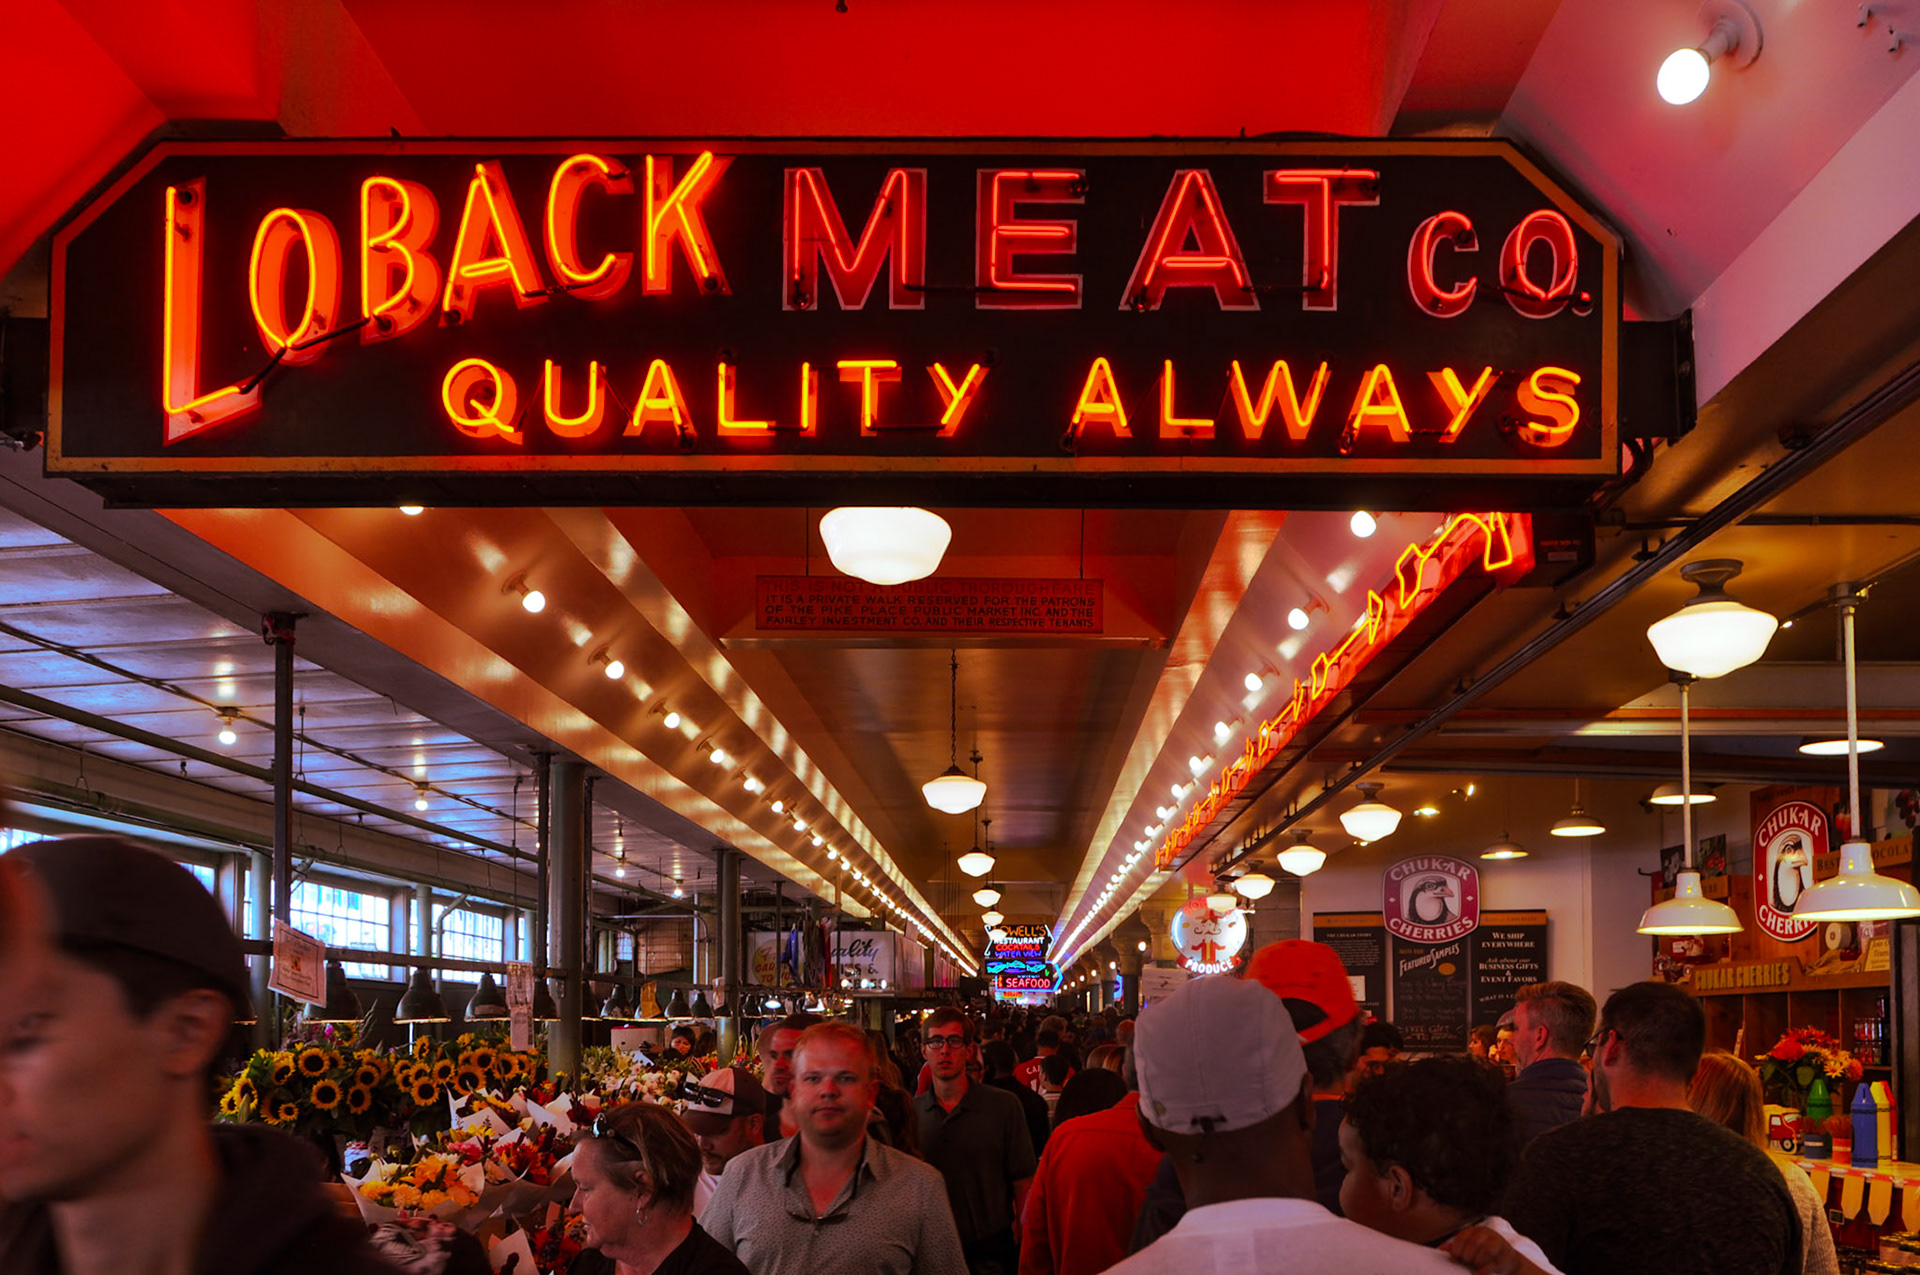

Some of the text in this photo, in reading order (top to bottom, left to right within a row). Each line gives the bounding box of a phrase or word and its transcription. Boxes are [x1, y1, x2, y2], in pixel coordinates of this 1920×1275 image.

[163, 150, 735, 446] LOBACK
[783, 168, 1380, 311] MEAT
[442, 356, 1582, 449] QUALITY ALWAYS
[763, 580, 801, 592] THIS
[809, 581, 822, 591] IS
[830, 581, 865, 592] NOT
[962, 583, 1096, 595] THOROUGHFARE
[766, 594, 1096, 607] IT IS A PRIVATE WALK RESERVED FOR THE PATRONS
[765, 605, 785, 614] OF
[790, 605, 814, 615] THE
[821, 606, 854, 615] PIKE
[861, 606, 907, 616] PLACE
[914, 607, 966, 617] PUBLIC
[967, 607, 1017, 617] MARKET
[1045, 608, 1069, 618] AND
[1071, 609, 1095, 618] THE
[822, 617, 899, 626] INVESTMENT
[926, 617, 948, 627] AND
[953, 618, 985, 627] THEIR
[990, 618, 1046, 627] RESPECTIVE
[1050, 619, 1095, 628] TENANTS
[1758, 806, 1822, 847] CHUKAR
[1390, 858, 1471, 881] CHUKAR
[1758, 904, 1816, 935] CHERR
[993, 924, 1047, 937] OWELL'S
[1389, 915, 1474, 940] CHERRIES
[993, 936, 1045, 945] RSTAURANT
[1492, 932, 1525, 940] WE SHIP
[831, 938, 880, 962] uality
[995, 943, 1041, 952] COCKTAILS
[1481, 941, 1536, 949] EVERYWHERE
[994, 950, 1042, 958] WATER VIEW
[1399, 953, 1432, 978] FEATURED
[1425, 942, 1461, 970] SAMPLES
[1184, 958, 1236, 975] PRODUCE
[1478, 962, 1539, 971] BUSINESS GIFTS
[1005, 977, 1051, 988] SEAFOOD
[1480, 976, 1538, 984] EVENT FAVORS
[1695, 962, 1790, 990] CHUKAR CHERRIES
